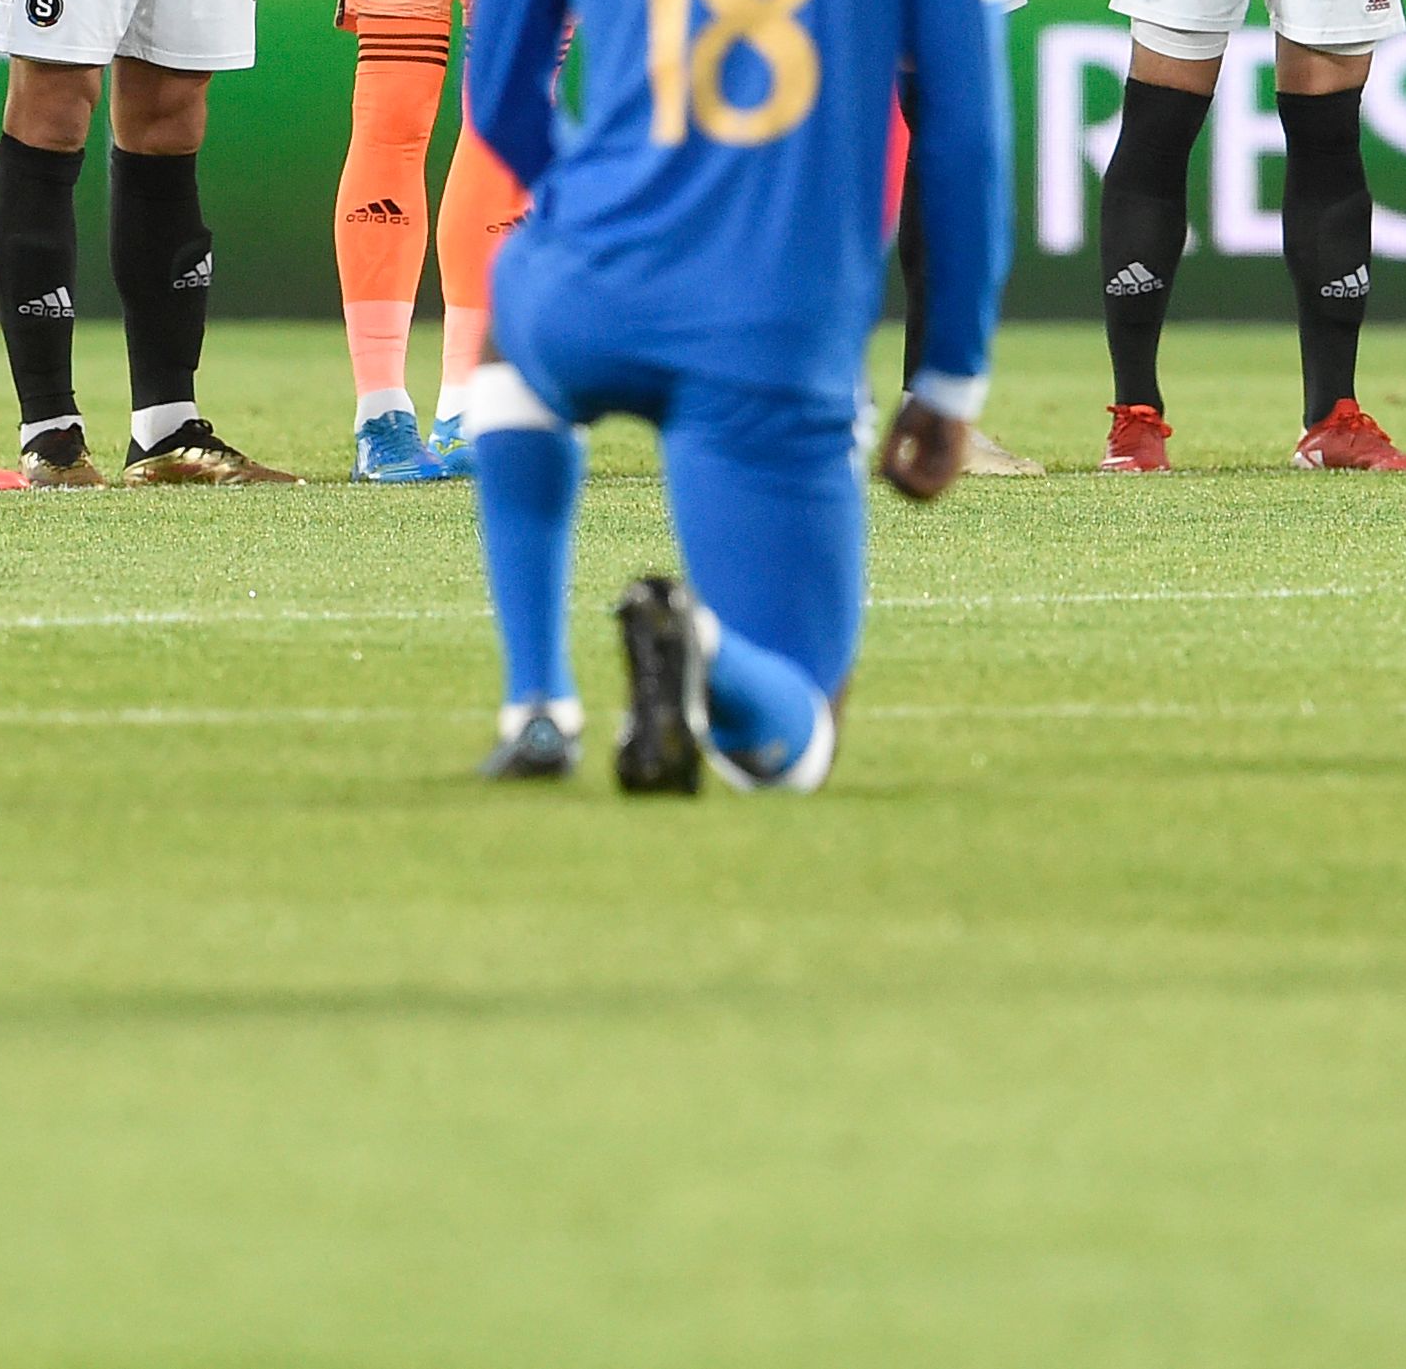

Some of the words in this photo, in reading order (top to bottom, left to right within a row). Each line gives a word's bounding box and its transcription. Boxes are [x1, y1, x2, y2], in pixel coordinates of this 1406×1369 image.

[346, 212, 410, 226] adidas
[1105, 280, 1164, 296] adidas
[1320, 283, 1370, 299] adida
